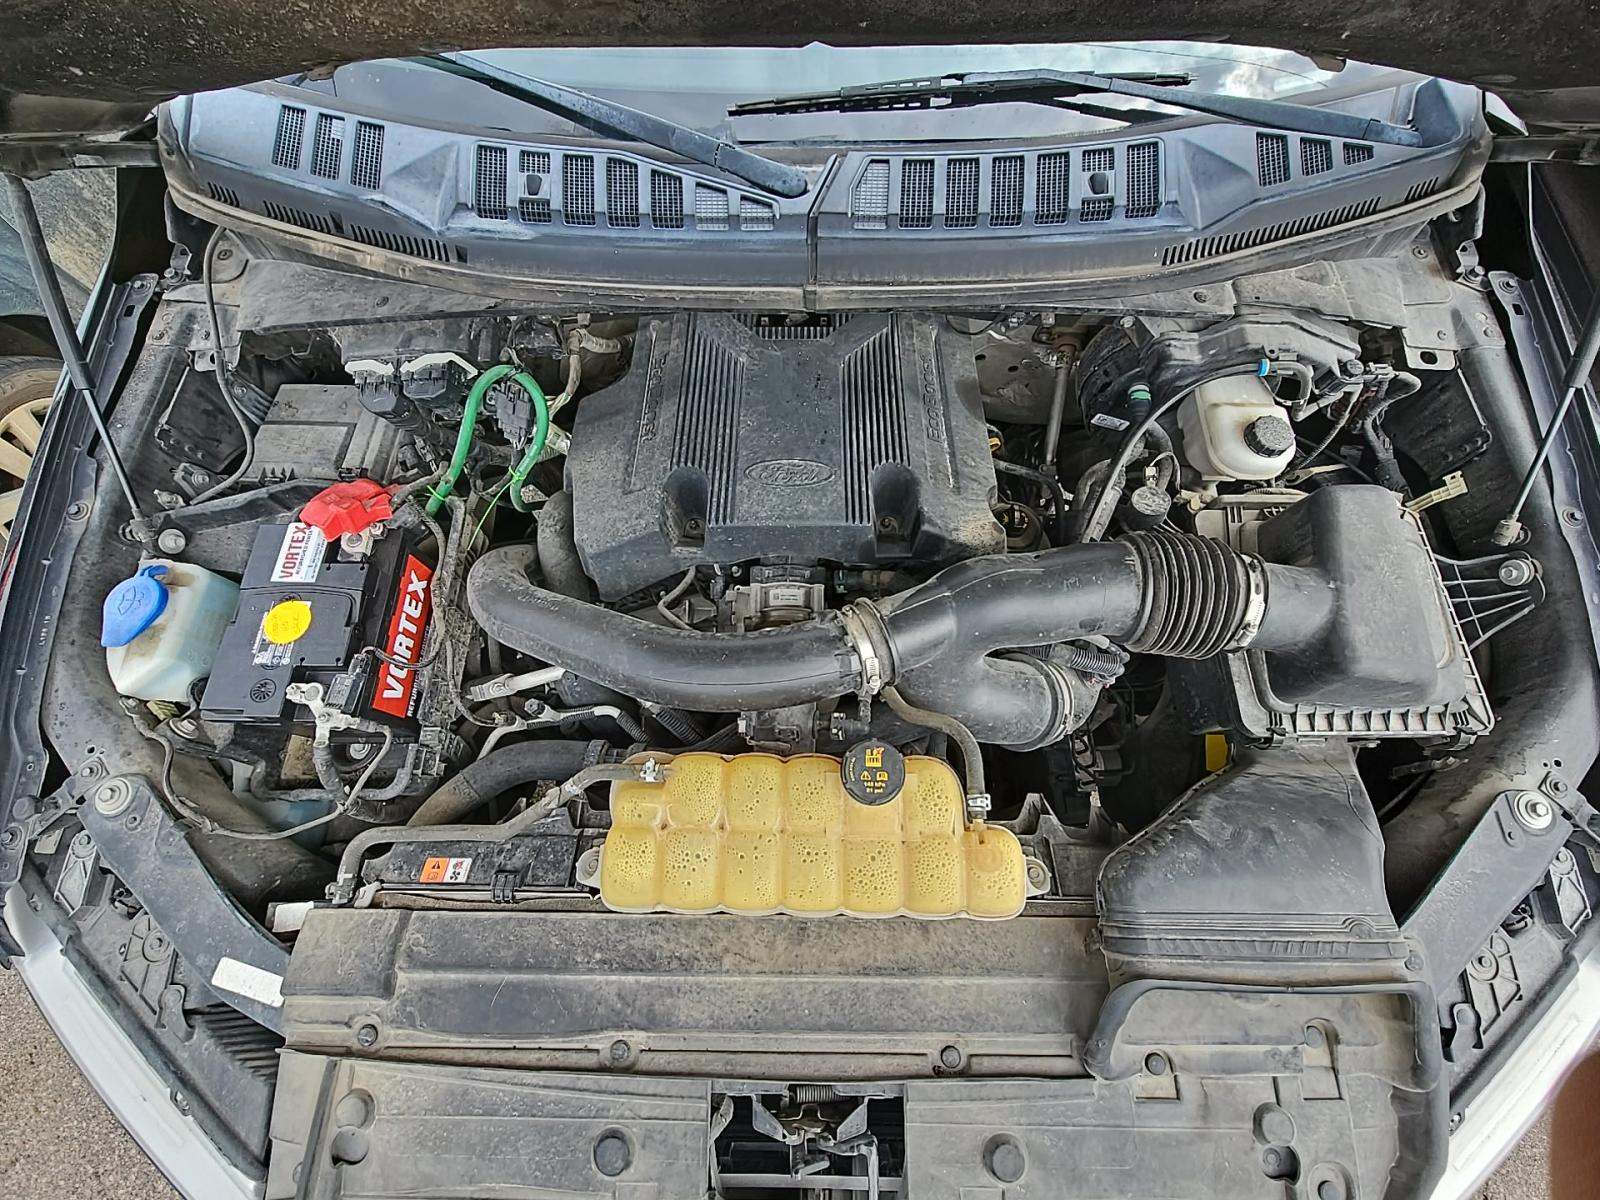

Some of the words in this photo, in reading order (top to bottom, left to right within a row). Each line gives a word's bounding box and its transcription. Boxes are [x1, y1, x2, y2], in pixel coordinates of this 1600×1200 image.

[759, 462, 819, 484] Ford
[278, 525, 307, 579] VORTEX
[382, 569, 428, 699] VORTEX
